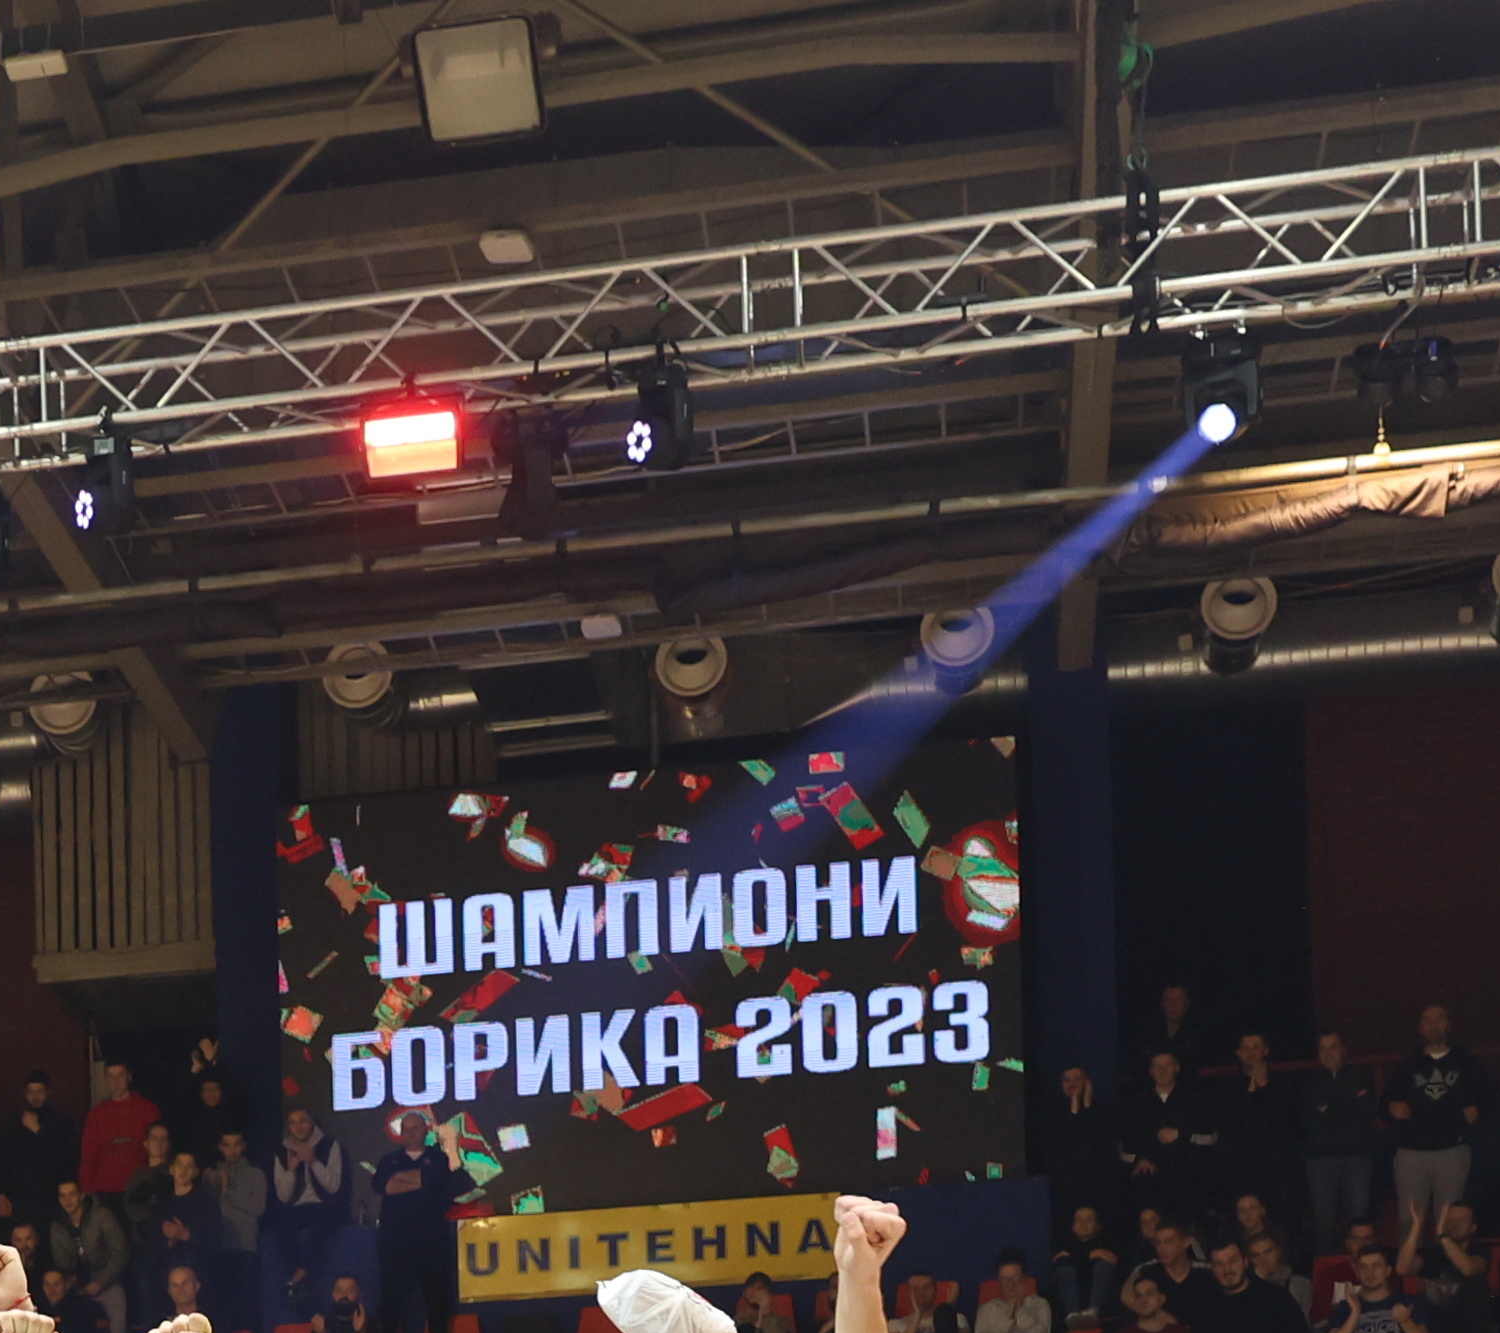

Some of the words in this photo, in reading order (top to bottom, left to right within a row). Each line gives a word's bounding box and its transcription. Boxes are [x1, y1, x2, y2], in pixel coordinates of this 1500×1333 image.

[378, 855, 917, 980] ШАМПИОНИ
[331, 1003, 700, 1111] БОРИКА
[735, 979, 991, 1079] 2023
[466, 1216, 834, 1278] UNITEHNA
